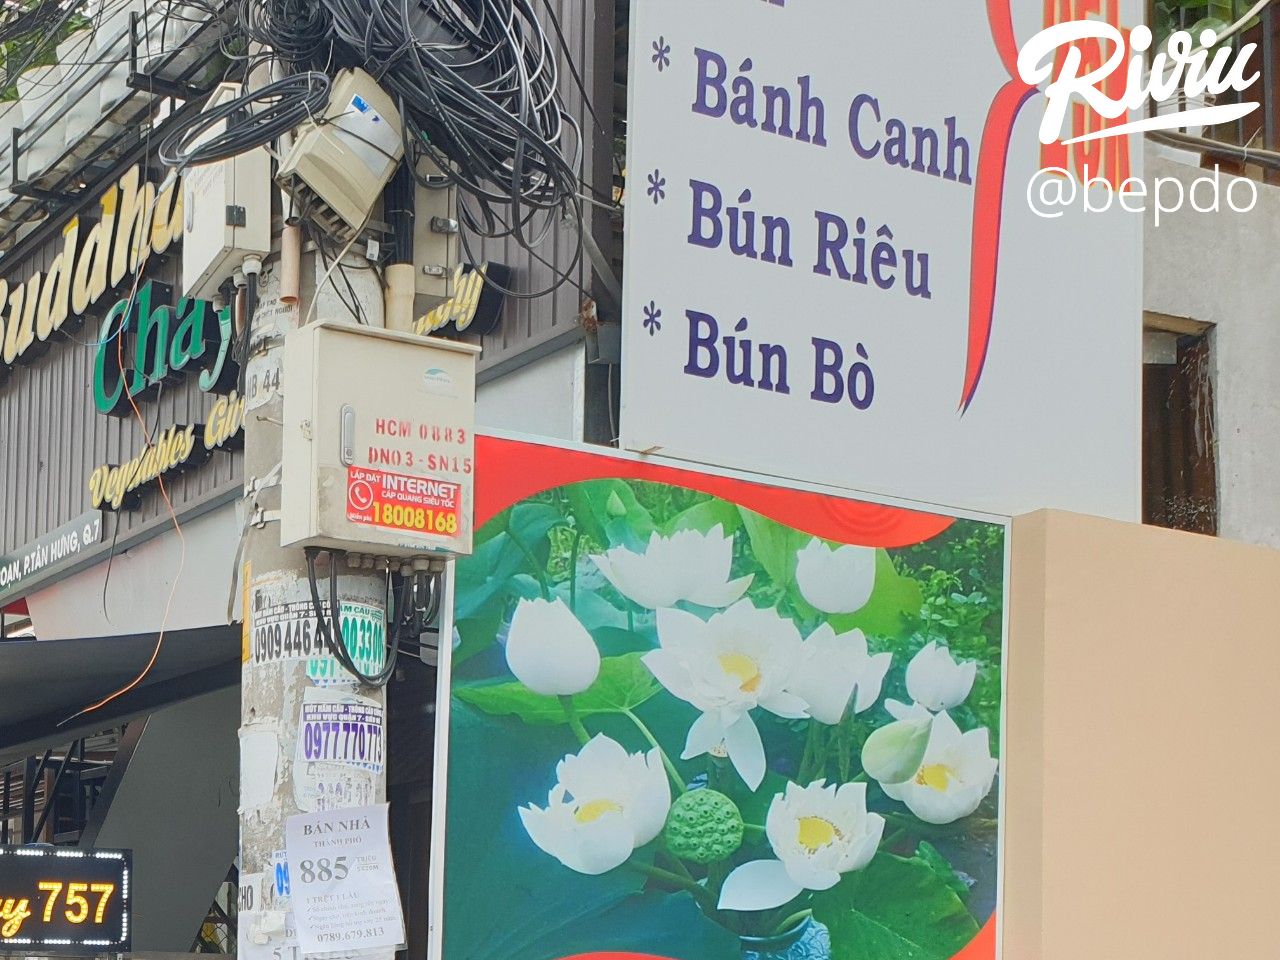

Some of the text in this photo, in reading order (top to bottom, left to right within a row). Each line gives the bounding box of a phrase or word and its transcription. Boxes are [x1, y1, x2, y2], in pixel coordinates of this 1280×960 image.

[691, 47, 827, 148] Bánh
[848, 93, 972, 186] Canh
[687, 178, 932, 299] Bún Riêu
[684, 309, 875, 411] Bún Bò
[376, 418, 466, 444] HCM 0883
[382, 474, 458, 499] INTERNET
[82, 518, 100, 546] Q.7
[373, 501, 458, 534] 18008168
[304, 815, 372, 836] BÁN NHÀ
[299, 856, 349, 884] 885
[38, 882, 115, 925] 757
